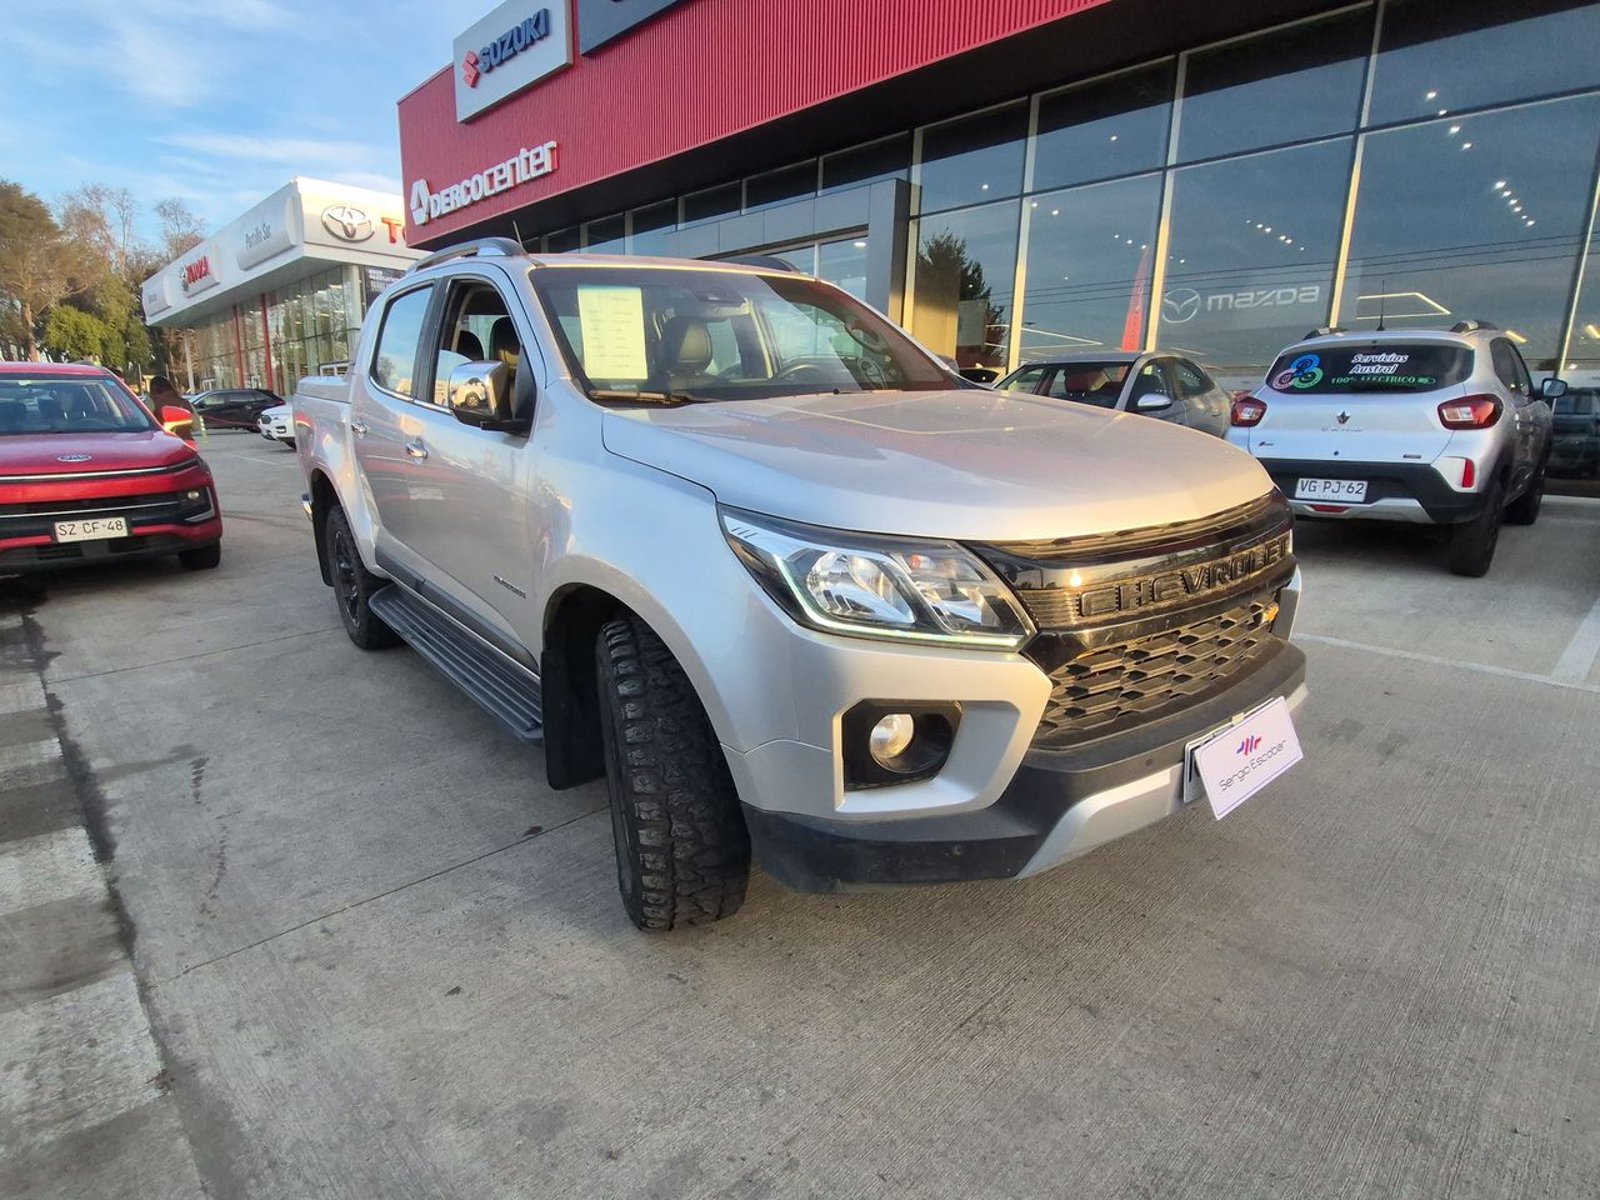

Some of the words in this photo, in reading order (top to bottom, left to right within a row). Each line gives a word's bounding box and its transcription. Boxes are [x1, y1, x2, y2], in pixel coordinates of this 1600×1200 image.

[479, 8, 550, 74] SUZUKI
[381, 216, 406, 245] T
[1349, 364, 1399, 374] Austral
[1351, 353, 1409, 363] Servicios
[1076, 536, 1288, 617] CHEVROLET
[1250, 739, 1287, 770] Escobar
